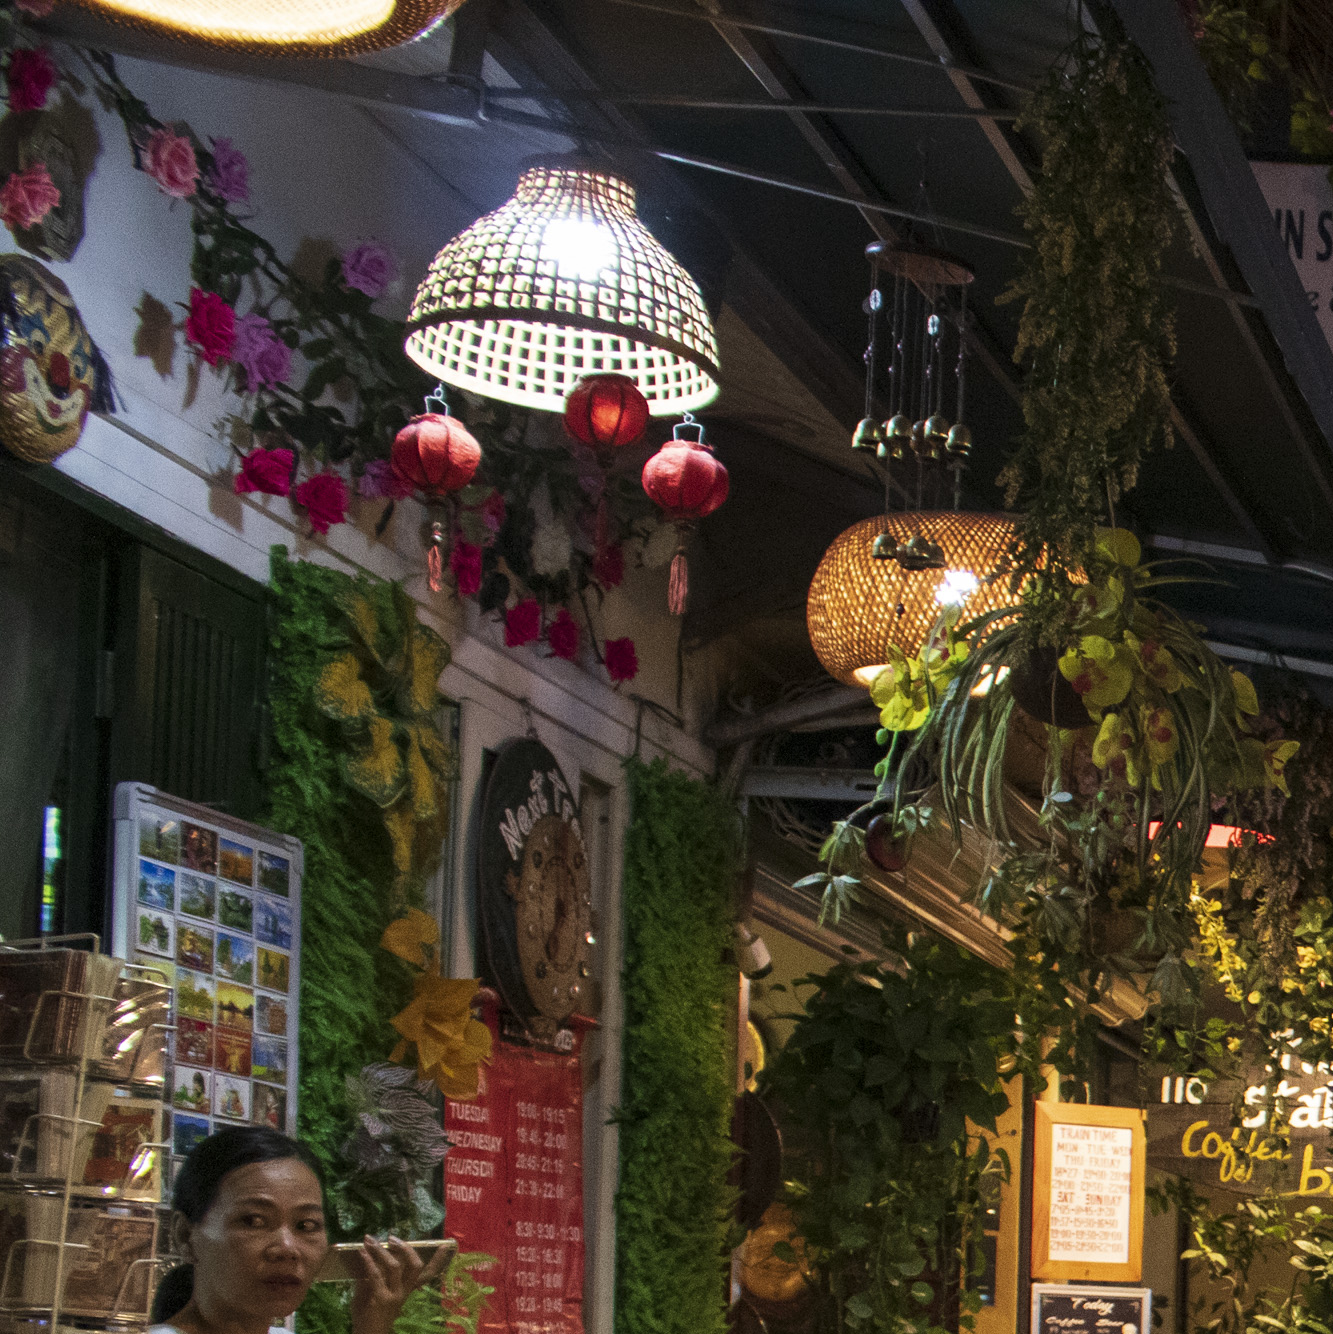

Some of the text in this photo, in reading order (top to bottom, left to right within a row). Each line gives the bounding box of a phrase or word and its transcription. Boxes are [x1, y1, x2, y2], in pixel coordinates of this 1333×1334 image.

[498, 769, 549, 861] Next
[1161, 1076, 1208, 1105] 110
[446, 1184, 482, 1203] FRIDAY
[1070, 1297, 1115, 1316] Today
